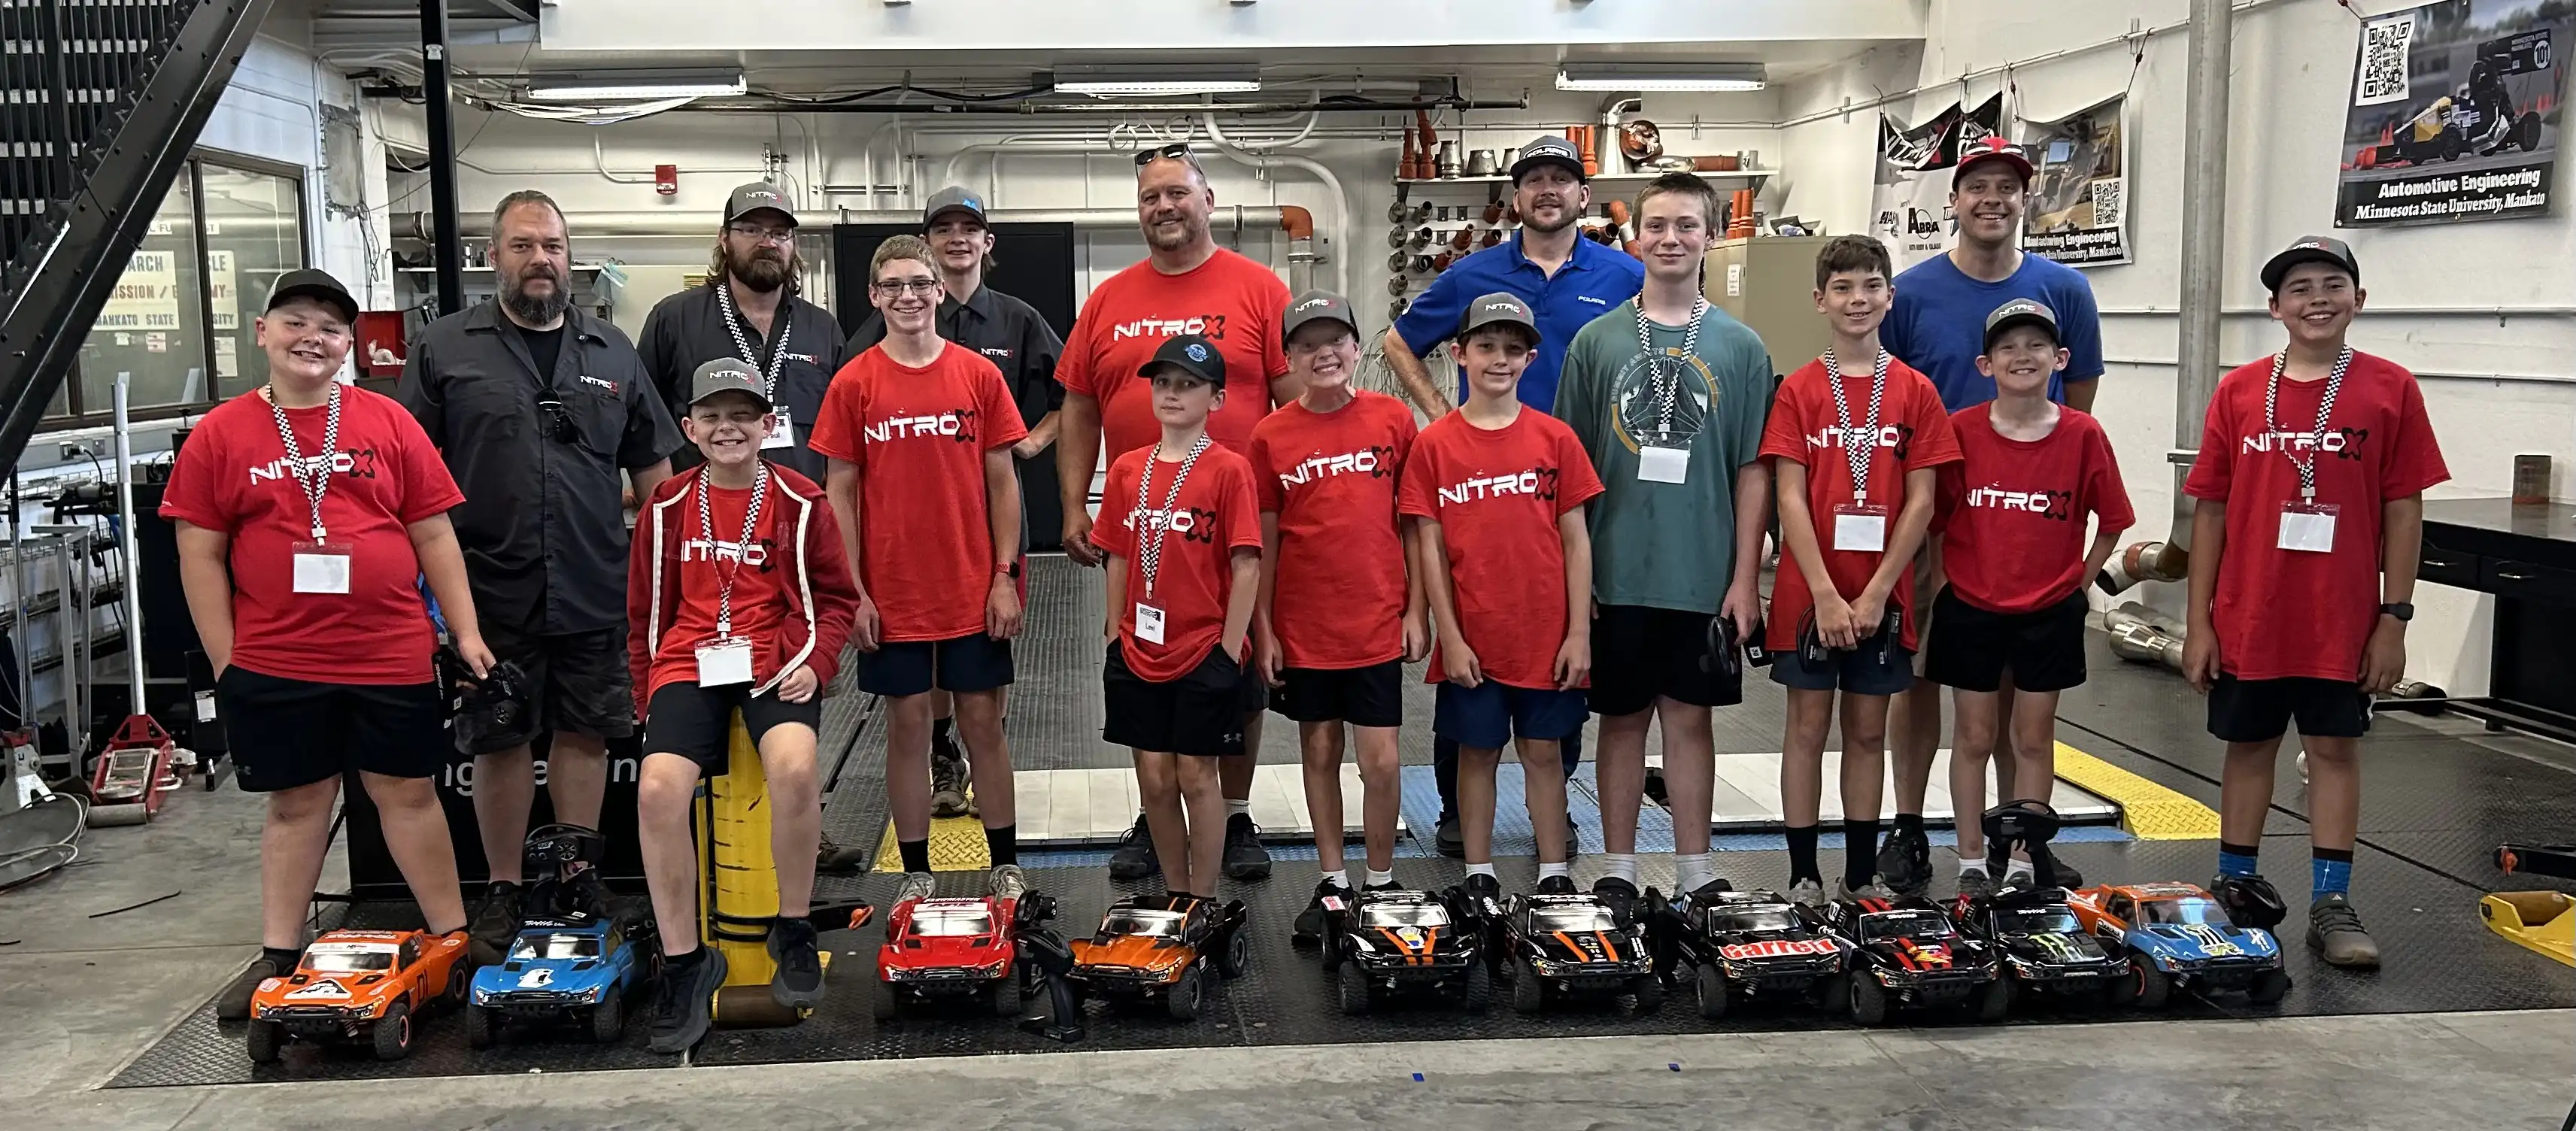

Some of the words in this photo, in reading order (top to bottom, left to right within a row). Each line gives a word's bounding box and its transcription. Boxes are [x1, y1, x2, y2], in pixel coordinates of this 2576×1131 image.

[2535, 44, 2549, 64] 101
[2378, 177, 2458, 198] Automotive
[2462, 168, 2541, 193] Engineering
[2354, 204, 2420, 219] Minnesota
[2420, 200, 2447, 215] State
[2449, 193, 2504, 214] University,
[2504, 190, 2545, 208] Mankato
[1907, 208, 1940, 234] ABRA
[2065, 230, 2117, 247] Engineering
[2089, 244, 2122, 258] Mankato
[146, 314, 174, 326] STATE
[1114, 314, 1225, 341] NITROX
[783, 353, 819, 365] NITROX
[981, 347, 1014, 358] NITROX
[580, 375, 619, 395] NITROX
[709, 370, 755, 384] NITROX
[865, 410, 975, 444] NITROX
[2243, 427, 2368, 462] NITROX
[249, 448, 375, 486] NITROX
[1279, 445, 1394, 490] NITROX
[1438, 467, 1558, 508] NITROX
[1966, 486, 2071, 520] NITROX
[681, 538, 778, 575] ITROX
